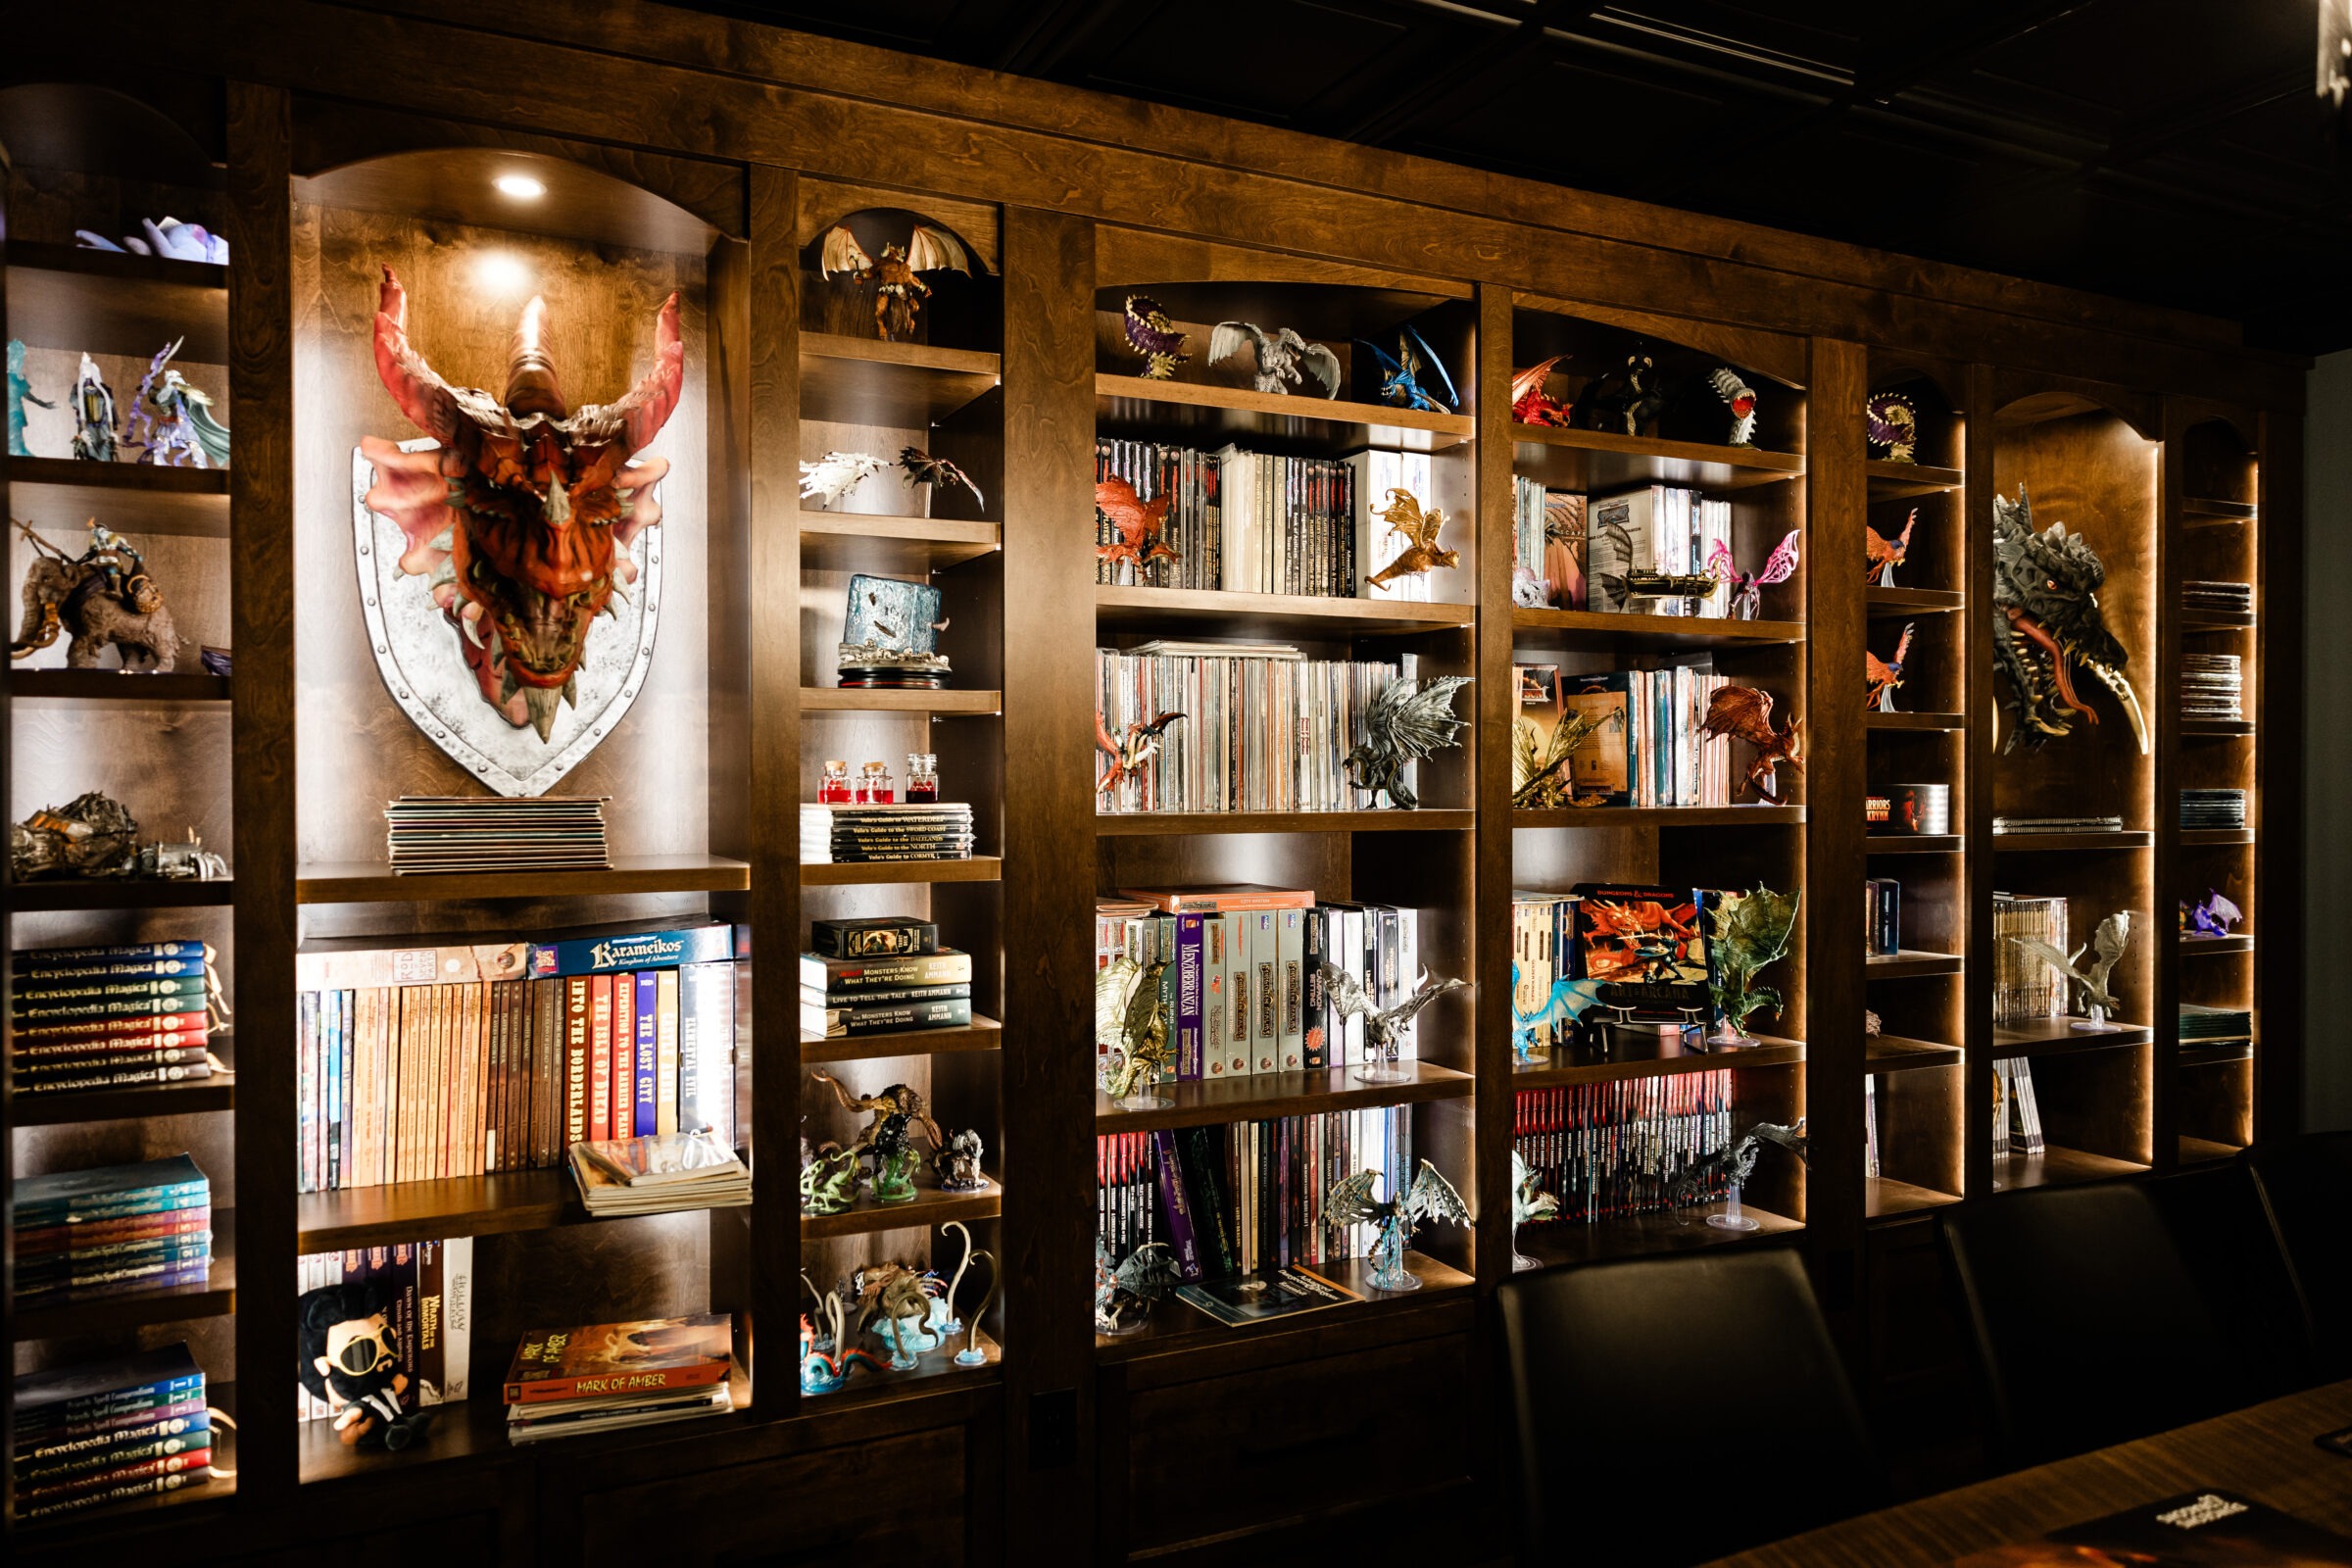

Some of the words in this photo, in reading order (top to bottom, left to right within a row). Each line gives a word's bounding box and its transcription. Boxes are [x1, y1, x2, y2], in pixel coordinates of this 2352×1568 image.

[1866, 799, 1891, 810] ARRIORS
[1634, 889, 1642, 898] &
[590, 939, 683, 969] Karameikos
[618, 957, 644, 966] Kingdom
[645, 956, 652, 964] of
[31, 966, 106, 979] Encyclopedia
[110, 962, 153, 974] Magica
[845, 976, 863, 985] WHAT
[865, 974, 893, 983] THEY'RE
[895, 972, 915, 981] DOING
[864, 967, 898, 976] MONSTERS
[1181, 944, 1200, 1016] MENZOBERRANZAN
[25, 986, 102, 1000] Encyclopedia
[105, 982, 149, 994] Magica
[571, 980, 587, 1013] INTO
[833, 995, 848, 1004] LIVE
[860, 993, 875, 1002] TELL
[910, 989, 927, 998] KEITH
[28, 1004, 105, 1018] Encyclopedia
[108, 1000, 151, 1012] Magica
[595, 995, 609, 1021] THE
[618, 982, 629, 1034] EXPEDITION
[862, 1011, 894, 1020] MONSTERS
[928, 1012, 954, 1021] AMMANN
[571, 1017, 586, 1045] THE
[640, 1014, 654, 1039] THE
[851, 1019, 868, 1028] WHAT
[29, 1040, 105, 1054] Encyclopedia
[109, 1036, 152, 1049] Magica
[595, 1026, 609, 1055] ISLE
[618, 1037, 629, 1049] TO
[618, 1051, 629, 1069] THE
[639, 1043, 654, 1071] LOST
[594, 1060, 608, 1076] OF
[33, 1076, 110, 1091] Encyclopedia
[113, 1070, 156, 1083] Magica
[617, 1071, 628, 1109] BARRIER
[639, 1077, 653, 1104] CITY
[685, 1076, 697, 1099] EVIL
[569, 1049, 585, 1143] BORDERLANDS
[594, 1081, 608, 1125] DREAD
[617, 1111, 628, 1140] PEAKS
[420, 1296, 432, 1349] IMMORTALS
[428, 1294, 441, 1330] WRATH
[576, 1381, 609, 1394] MARK
[611, 1379, 625, 1391] OF
[627, 1373, 666, 1389] AMBER
[34, 1435, 111, 1458] Encyclopedia
[114, 1423, 157, 1442] Magica
